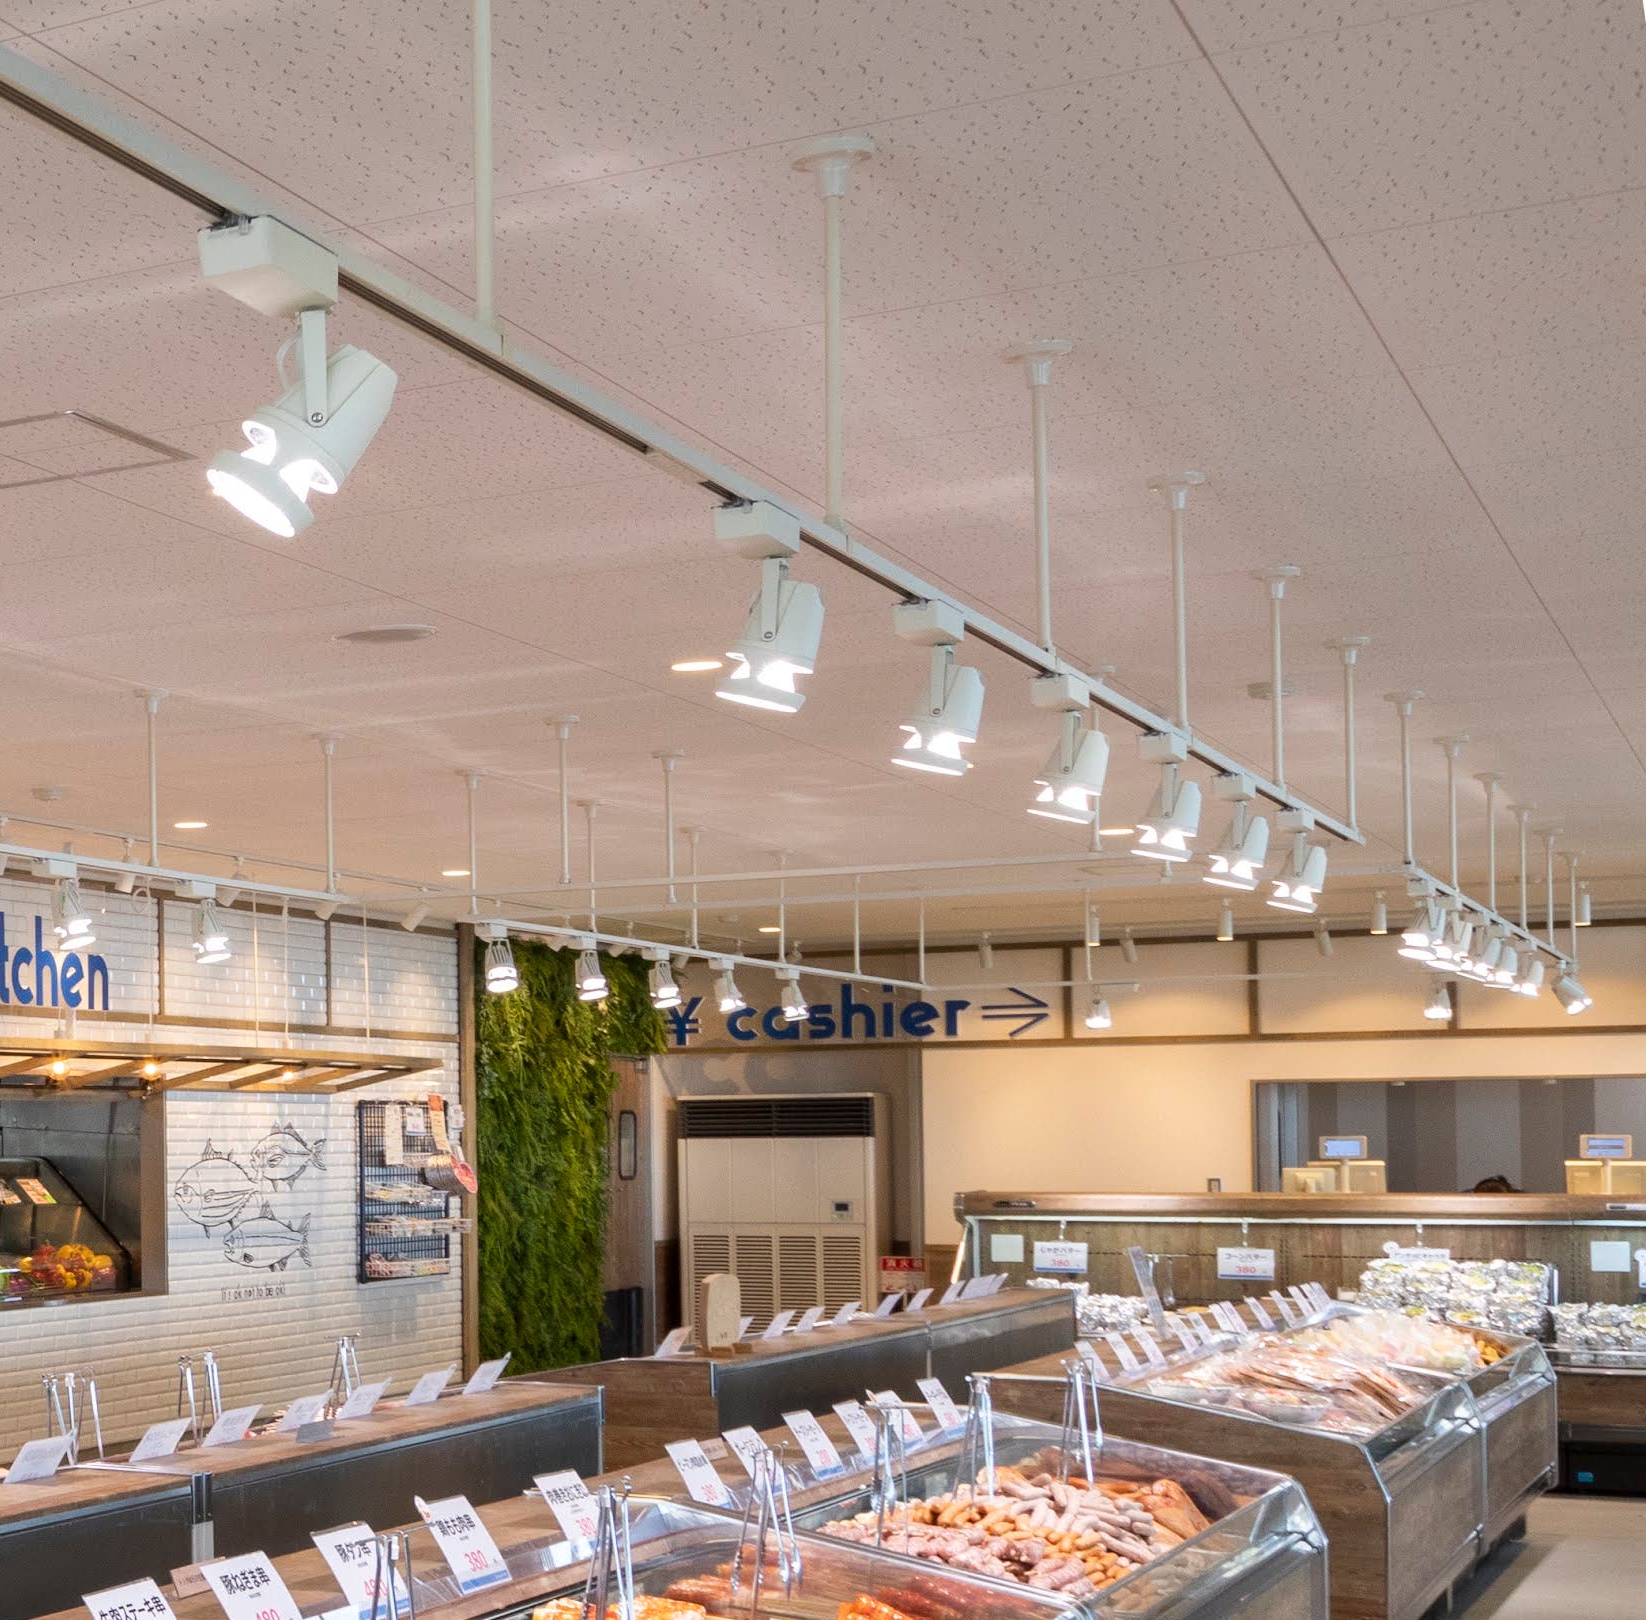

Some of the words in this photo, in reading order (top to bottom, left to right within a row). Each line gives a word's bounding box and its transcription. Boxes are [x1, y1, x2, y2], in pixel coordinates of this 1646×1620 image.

[726, 983, 971, 1041] cashier
[575, 1516, 598, 1537] 380
[464, 1549, 489, 1572] 380
[219, 1566, 271, 1595] 豚ねぎま串
